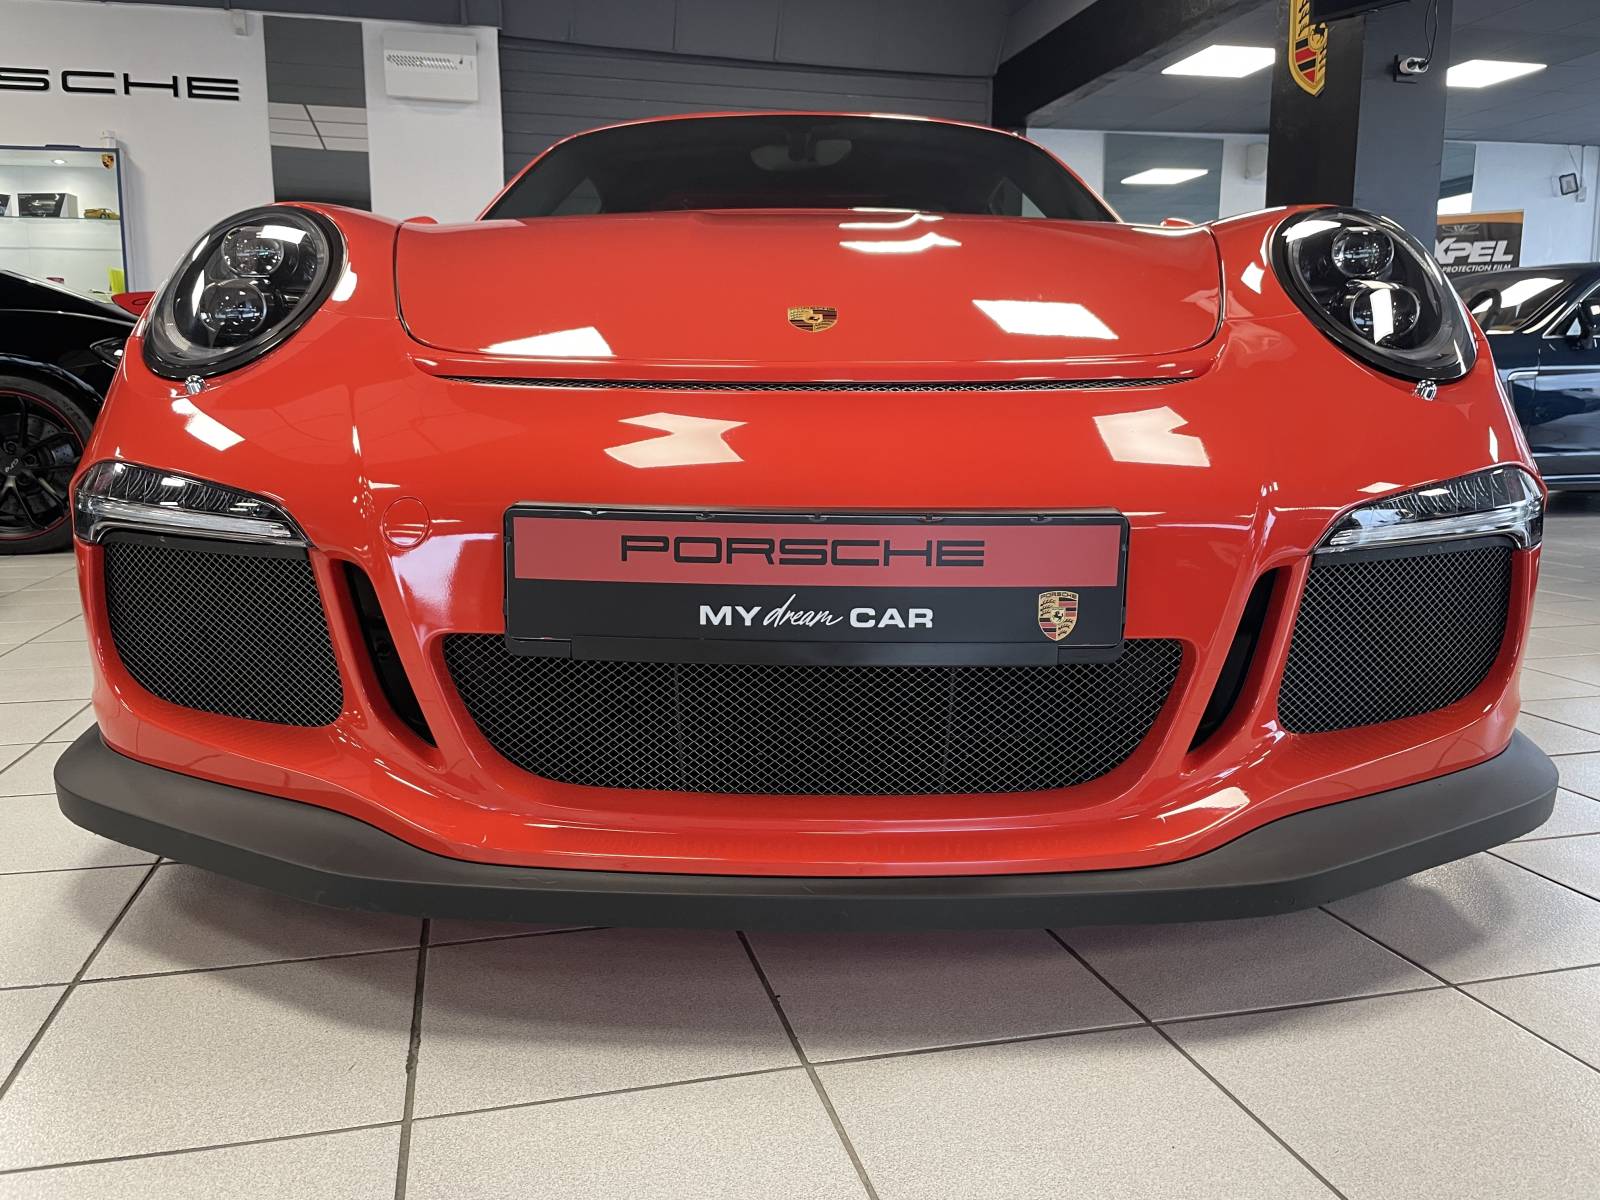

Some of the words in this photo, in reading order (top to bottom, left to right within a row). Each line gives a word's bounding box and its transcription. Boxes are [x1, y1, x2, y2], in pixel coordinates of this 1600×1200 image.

[0, 67, 240, 101] SCHE
[1434, 237, 1513, 264] XPEL
[1442, 264, 1491, 273] PROTECTION
[621, 535, 985, 567] PORSCHE
[699, 605, 762, 627] MY
[762, 593, 843, 628] dream
[849, 607, 934, 629] CAR
